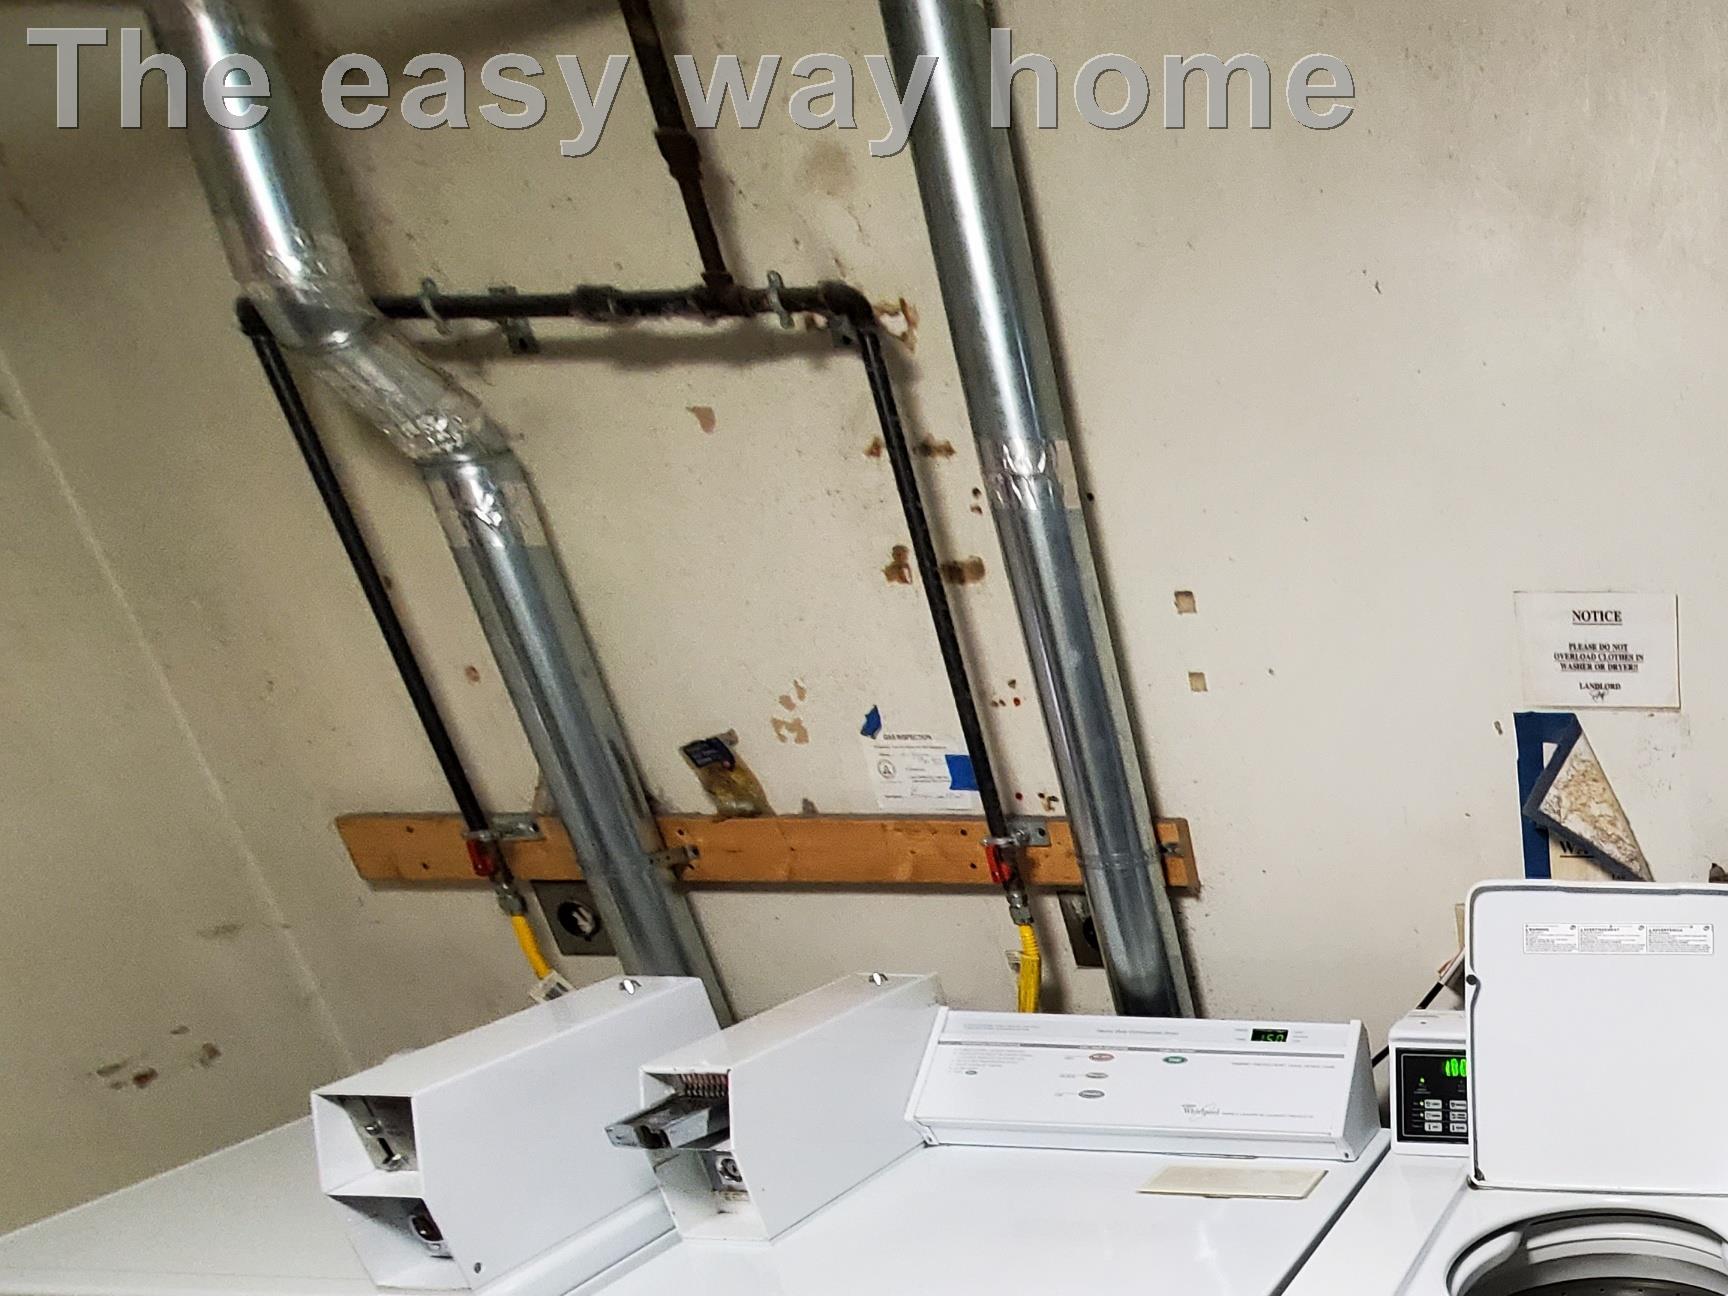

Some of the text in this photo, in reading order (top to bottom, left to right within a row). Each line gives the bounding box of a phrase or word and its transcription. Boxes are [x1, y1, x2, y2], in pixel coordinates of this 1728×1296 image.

[1572, 610, 1623, 623] NOTICE
[1569, 643, 1628, 652] PLEASE DO NOT
[1554, 653, 1597, 661] OVERLOAD
[1598, 653, 1634, 662] CLOTHES
[1560, 663, 1593, 671] WASHER
[1595, 663, 1606, 671] OR
[1579, 682, 1622, 691] LANDLORD
